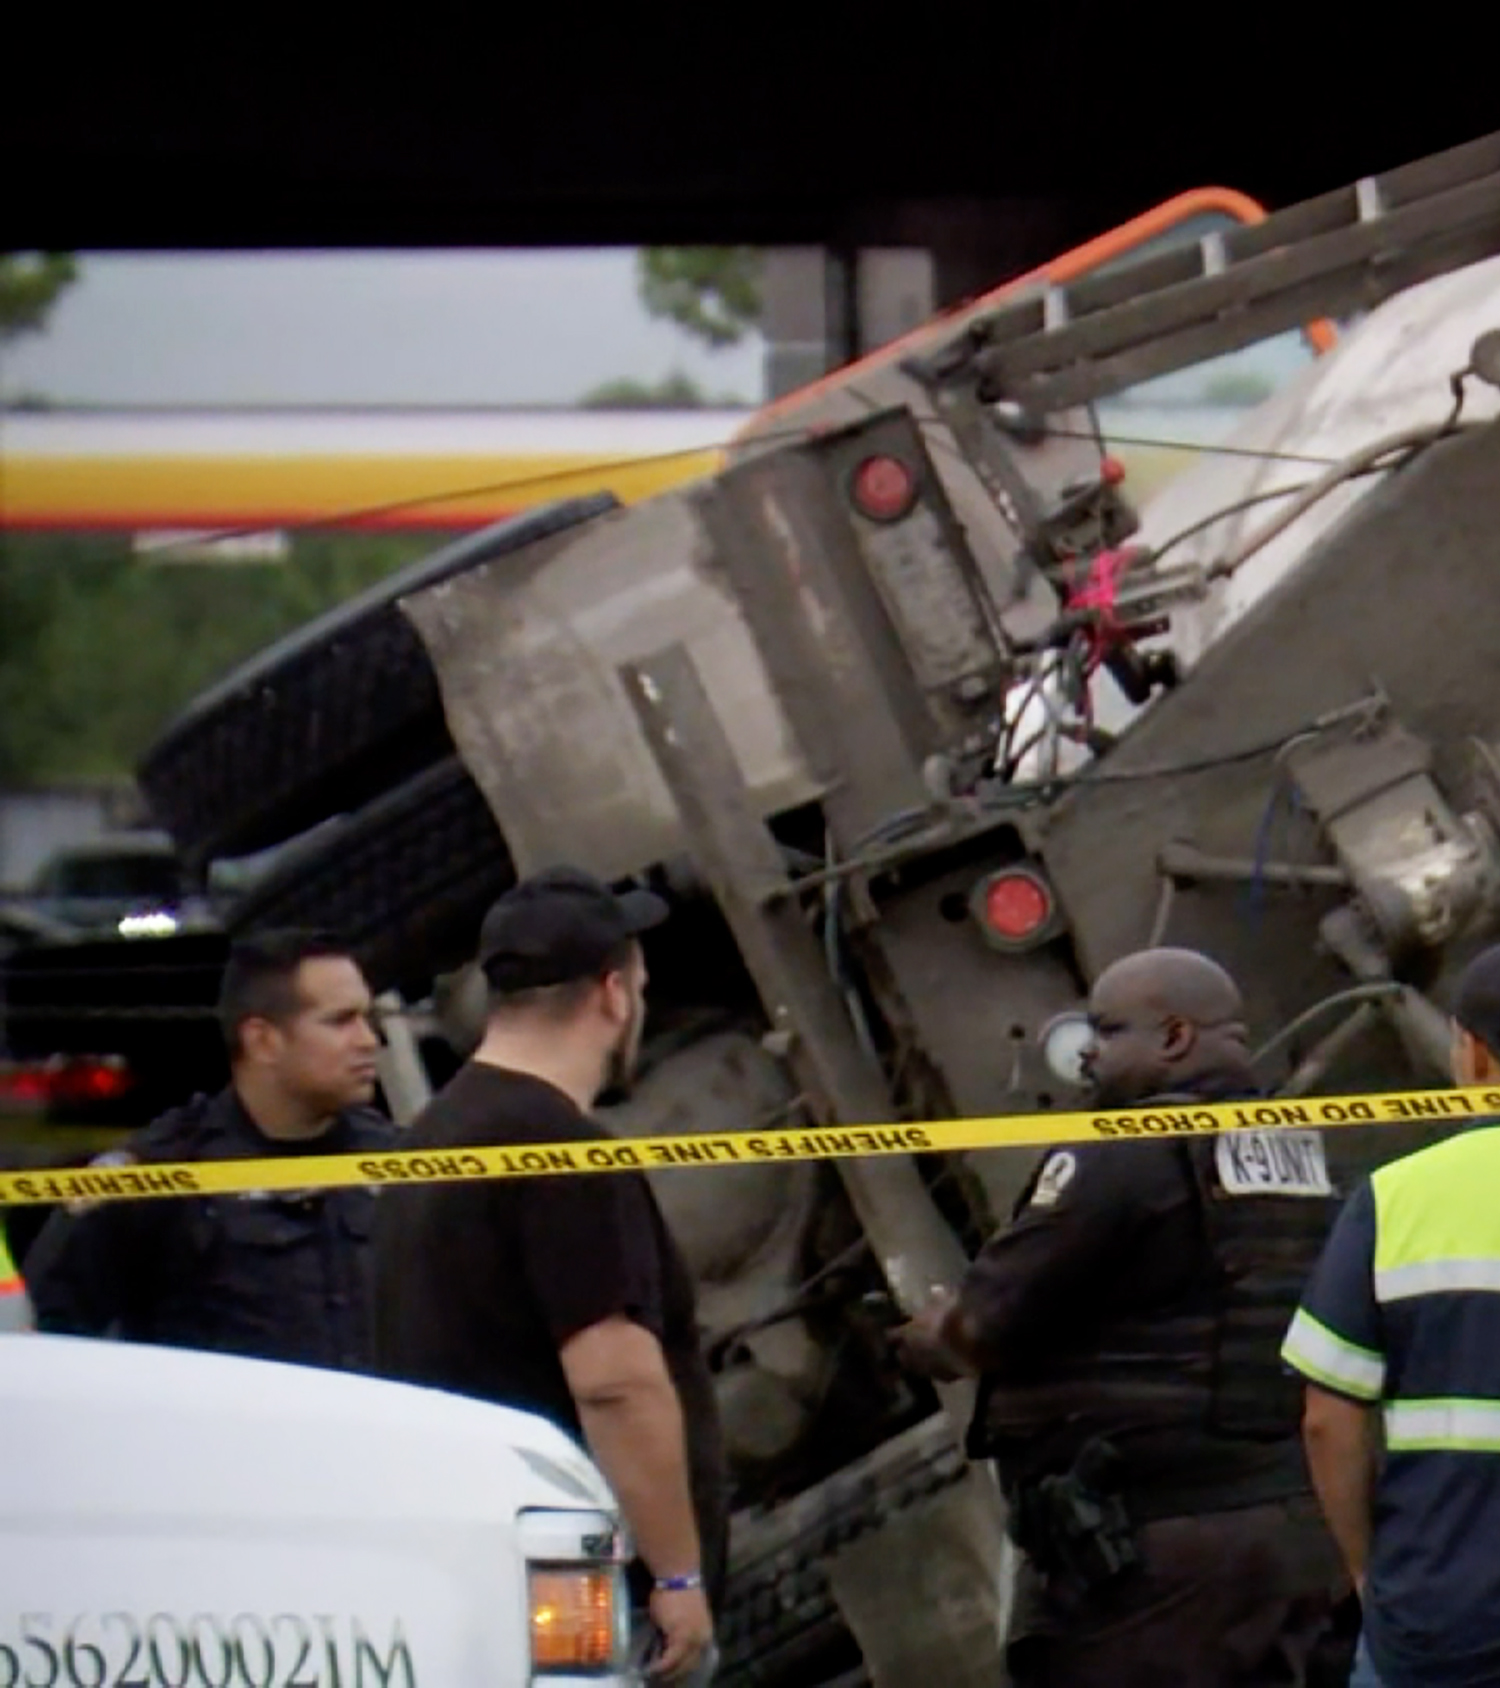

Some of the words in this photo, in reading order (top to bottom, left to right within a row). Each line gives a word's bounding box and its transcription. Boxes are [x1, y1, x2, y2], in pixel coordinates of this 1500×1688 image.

[1232, 1103, 1312, 1129] NOT
[1321, 1099, 1376, 1123] DO
[1383, 1091, 1474, 1119] LINE
[1092, 1111, 1221, 1137] CROSS
[650, 1139, 740, 1164] LINE
[746, 1127, 933, 1158] SHERIFFS
[357, 1153, 488, 1182] CROSS
[501, 1150, 577, 1173] NOT
[586, 1145, 641, 1168] DO
[1226, 1133, 1272, 1184] K-9
[1266, 1136, 1322, 1184] UNIT
[12, 1170, 201, 1199] SHERIFFS
